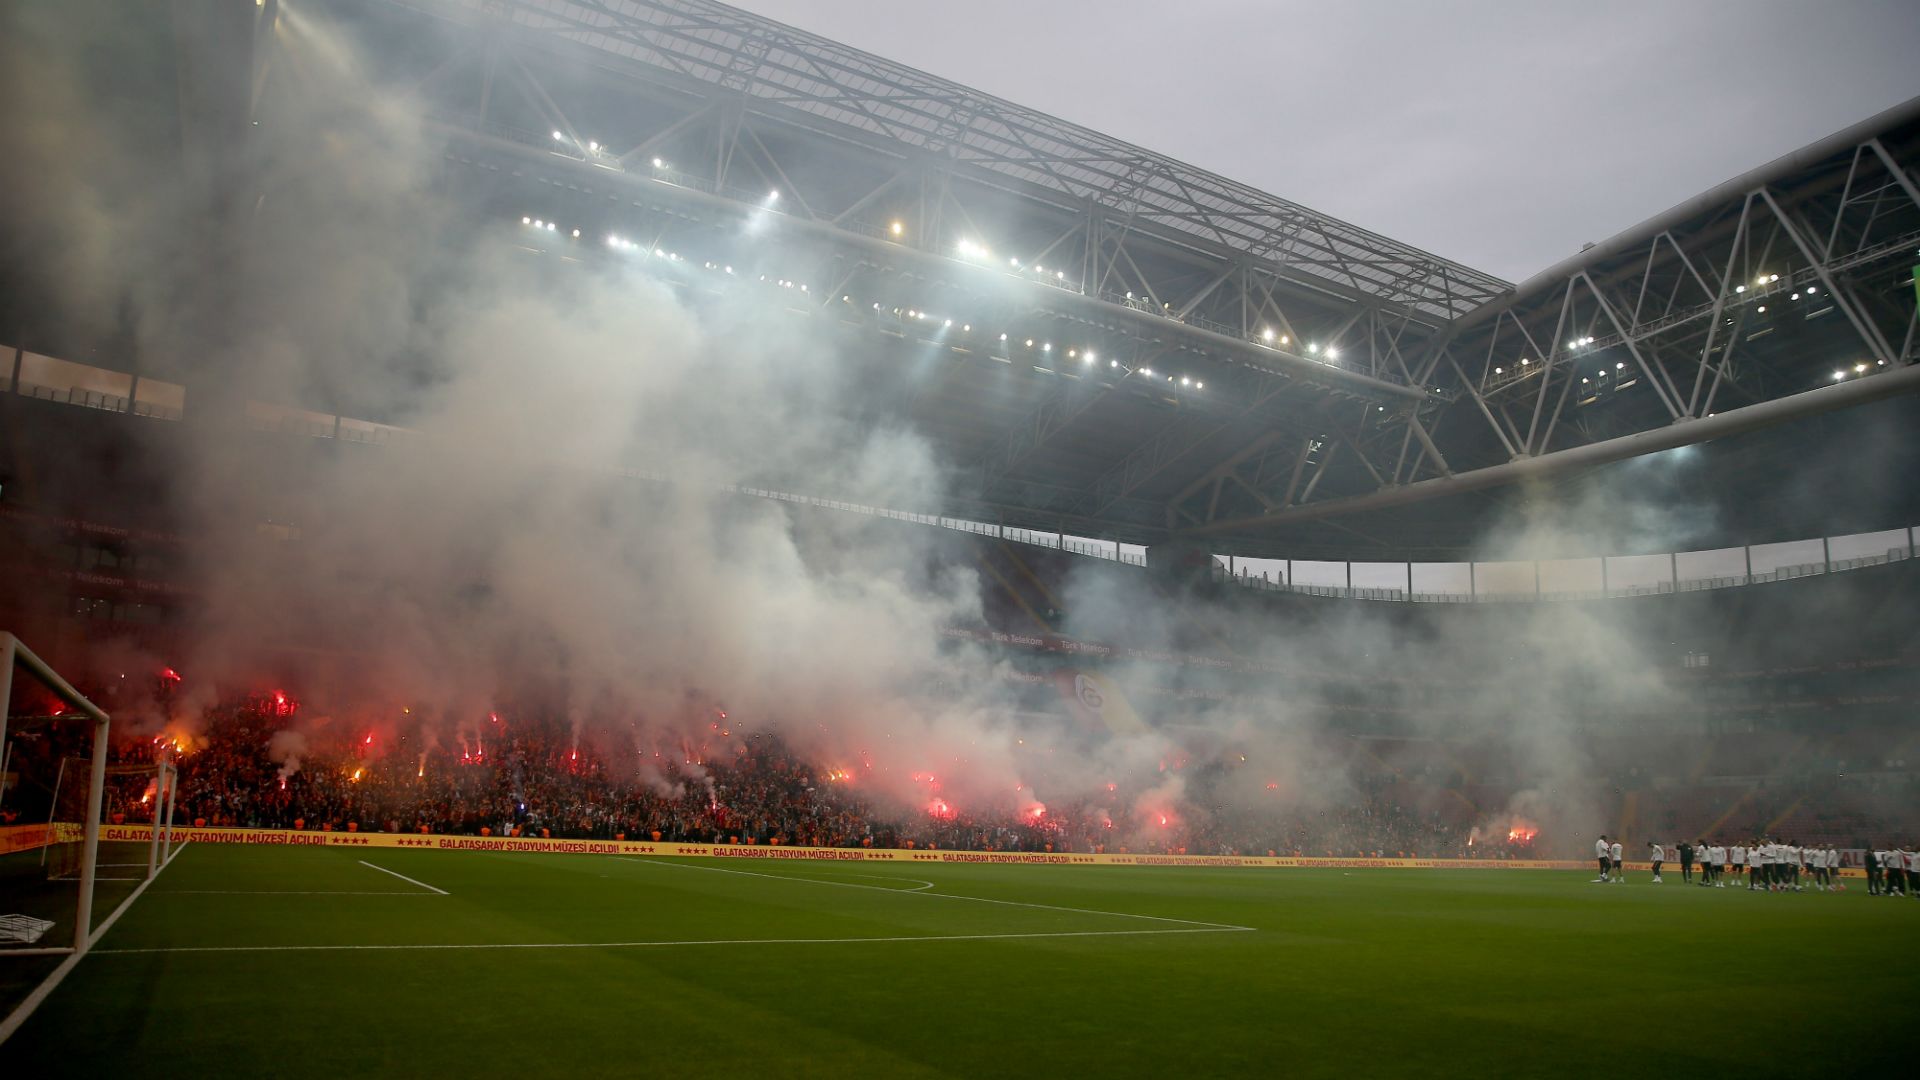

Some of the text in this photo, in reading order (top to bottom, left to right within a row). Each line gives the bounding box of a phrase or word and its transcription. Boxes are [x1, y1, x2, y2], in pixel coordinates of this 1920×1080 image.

[992, 631, 1043, 646] Türk Telekom
[1061, 640, 1110, 654] Türk Telekom
[190, 832, 243, 844] STADYUM
[247, 831, 288, 845] MÜZESİ
[290, 834, 327, 846] AÇILDI!
[440, 839, 620, 854] GALATASARAY STADYUM MÜZESİ AÇILDI!
[713, 847, 768, 858] GALATASARAY
[769, 849, 807, 859] STADYUM
[808, 848, 837, 860] MÜZESİ
